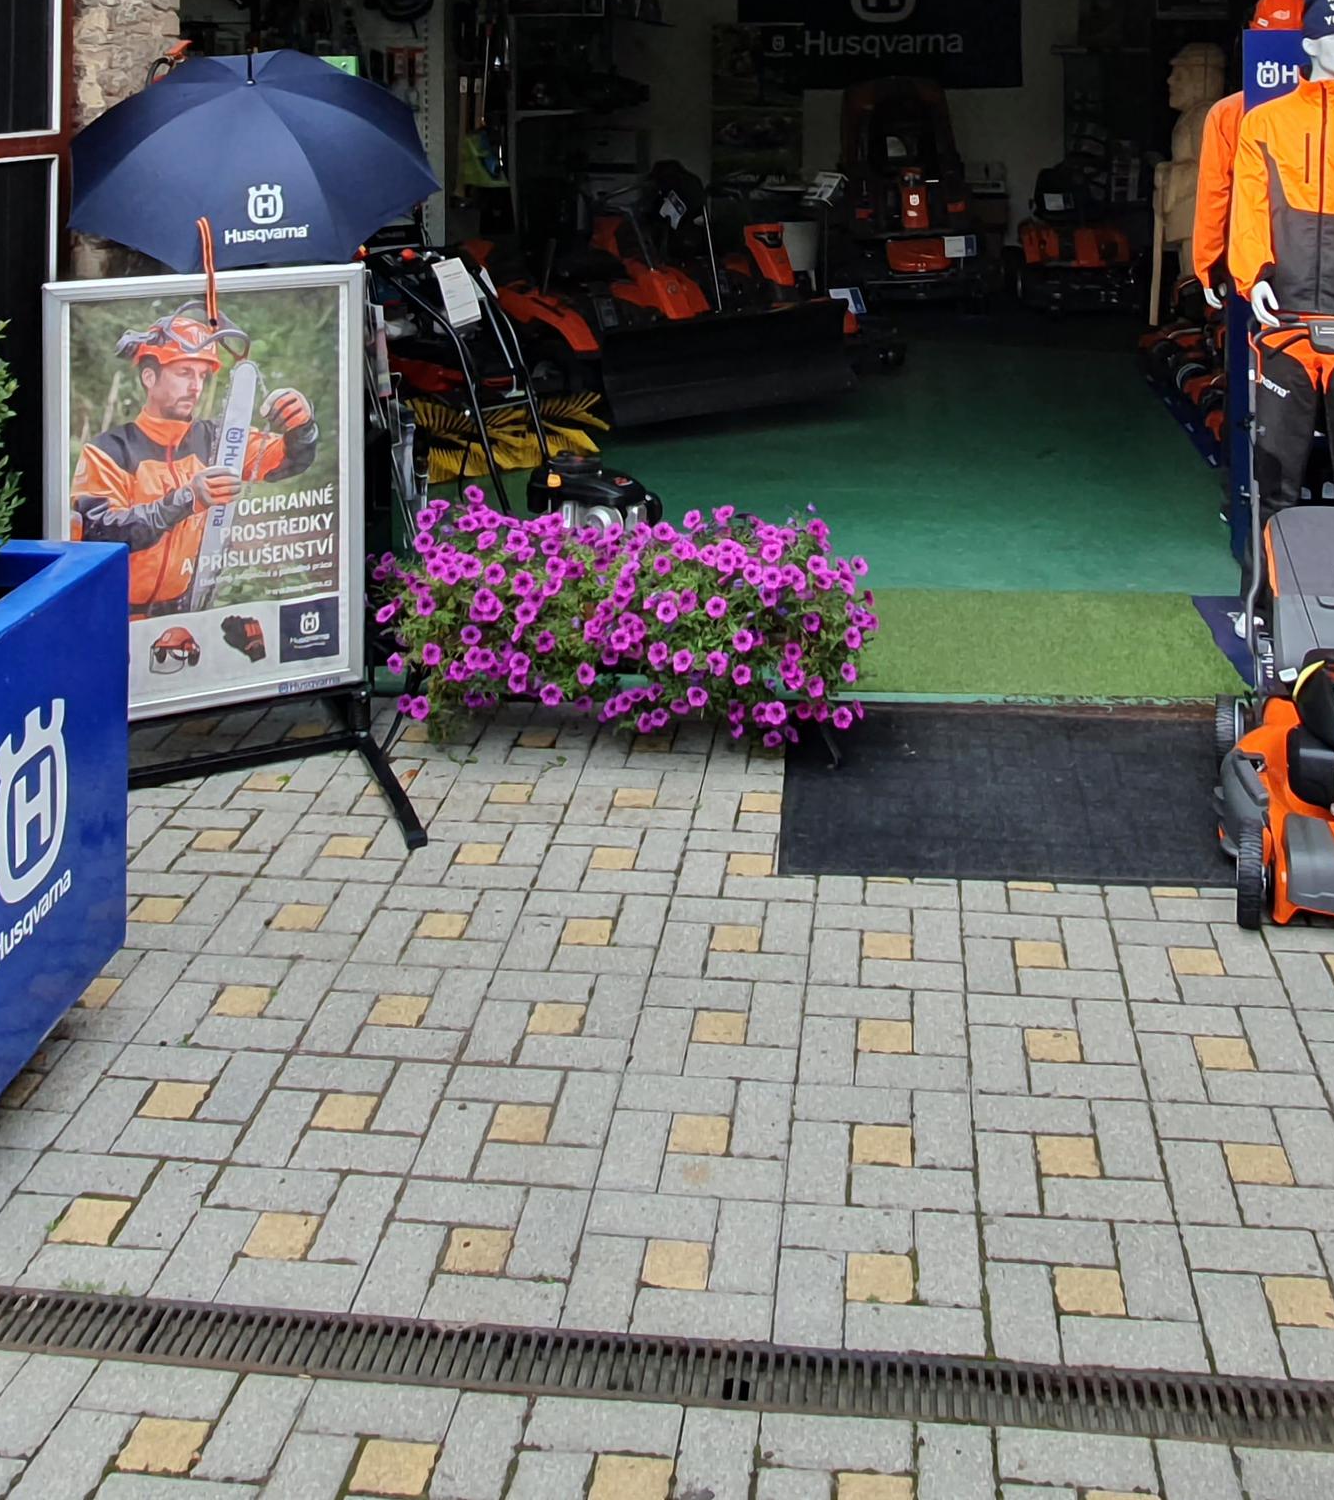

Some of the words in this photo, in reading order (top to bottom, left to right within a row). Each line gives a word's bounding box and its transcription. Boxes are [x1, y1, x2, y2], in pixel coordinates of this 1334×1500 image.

[804, 30, 963, 58] Husqvarna
[238, 484, 334, 516] OCHRANNÉ
[219, 512, 334, 543] PROSTŘEDKY
[180, 558, 194, 576] A
[199, 534, 333, 572] PŘÍSLUŠENSTVÍ
